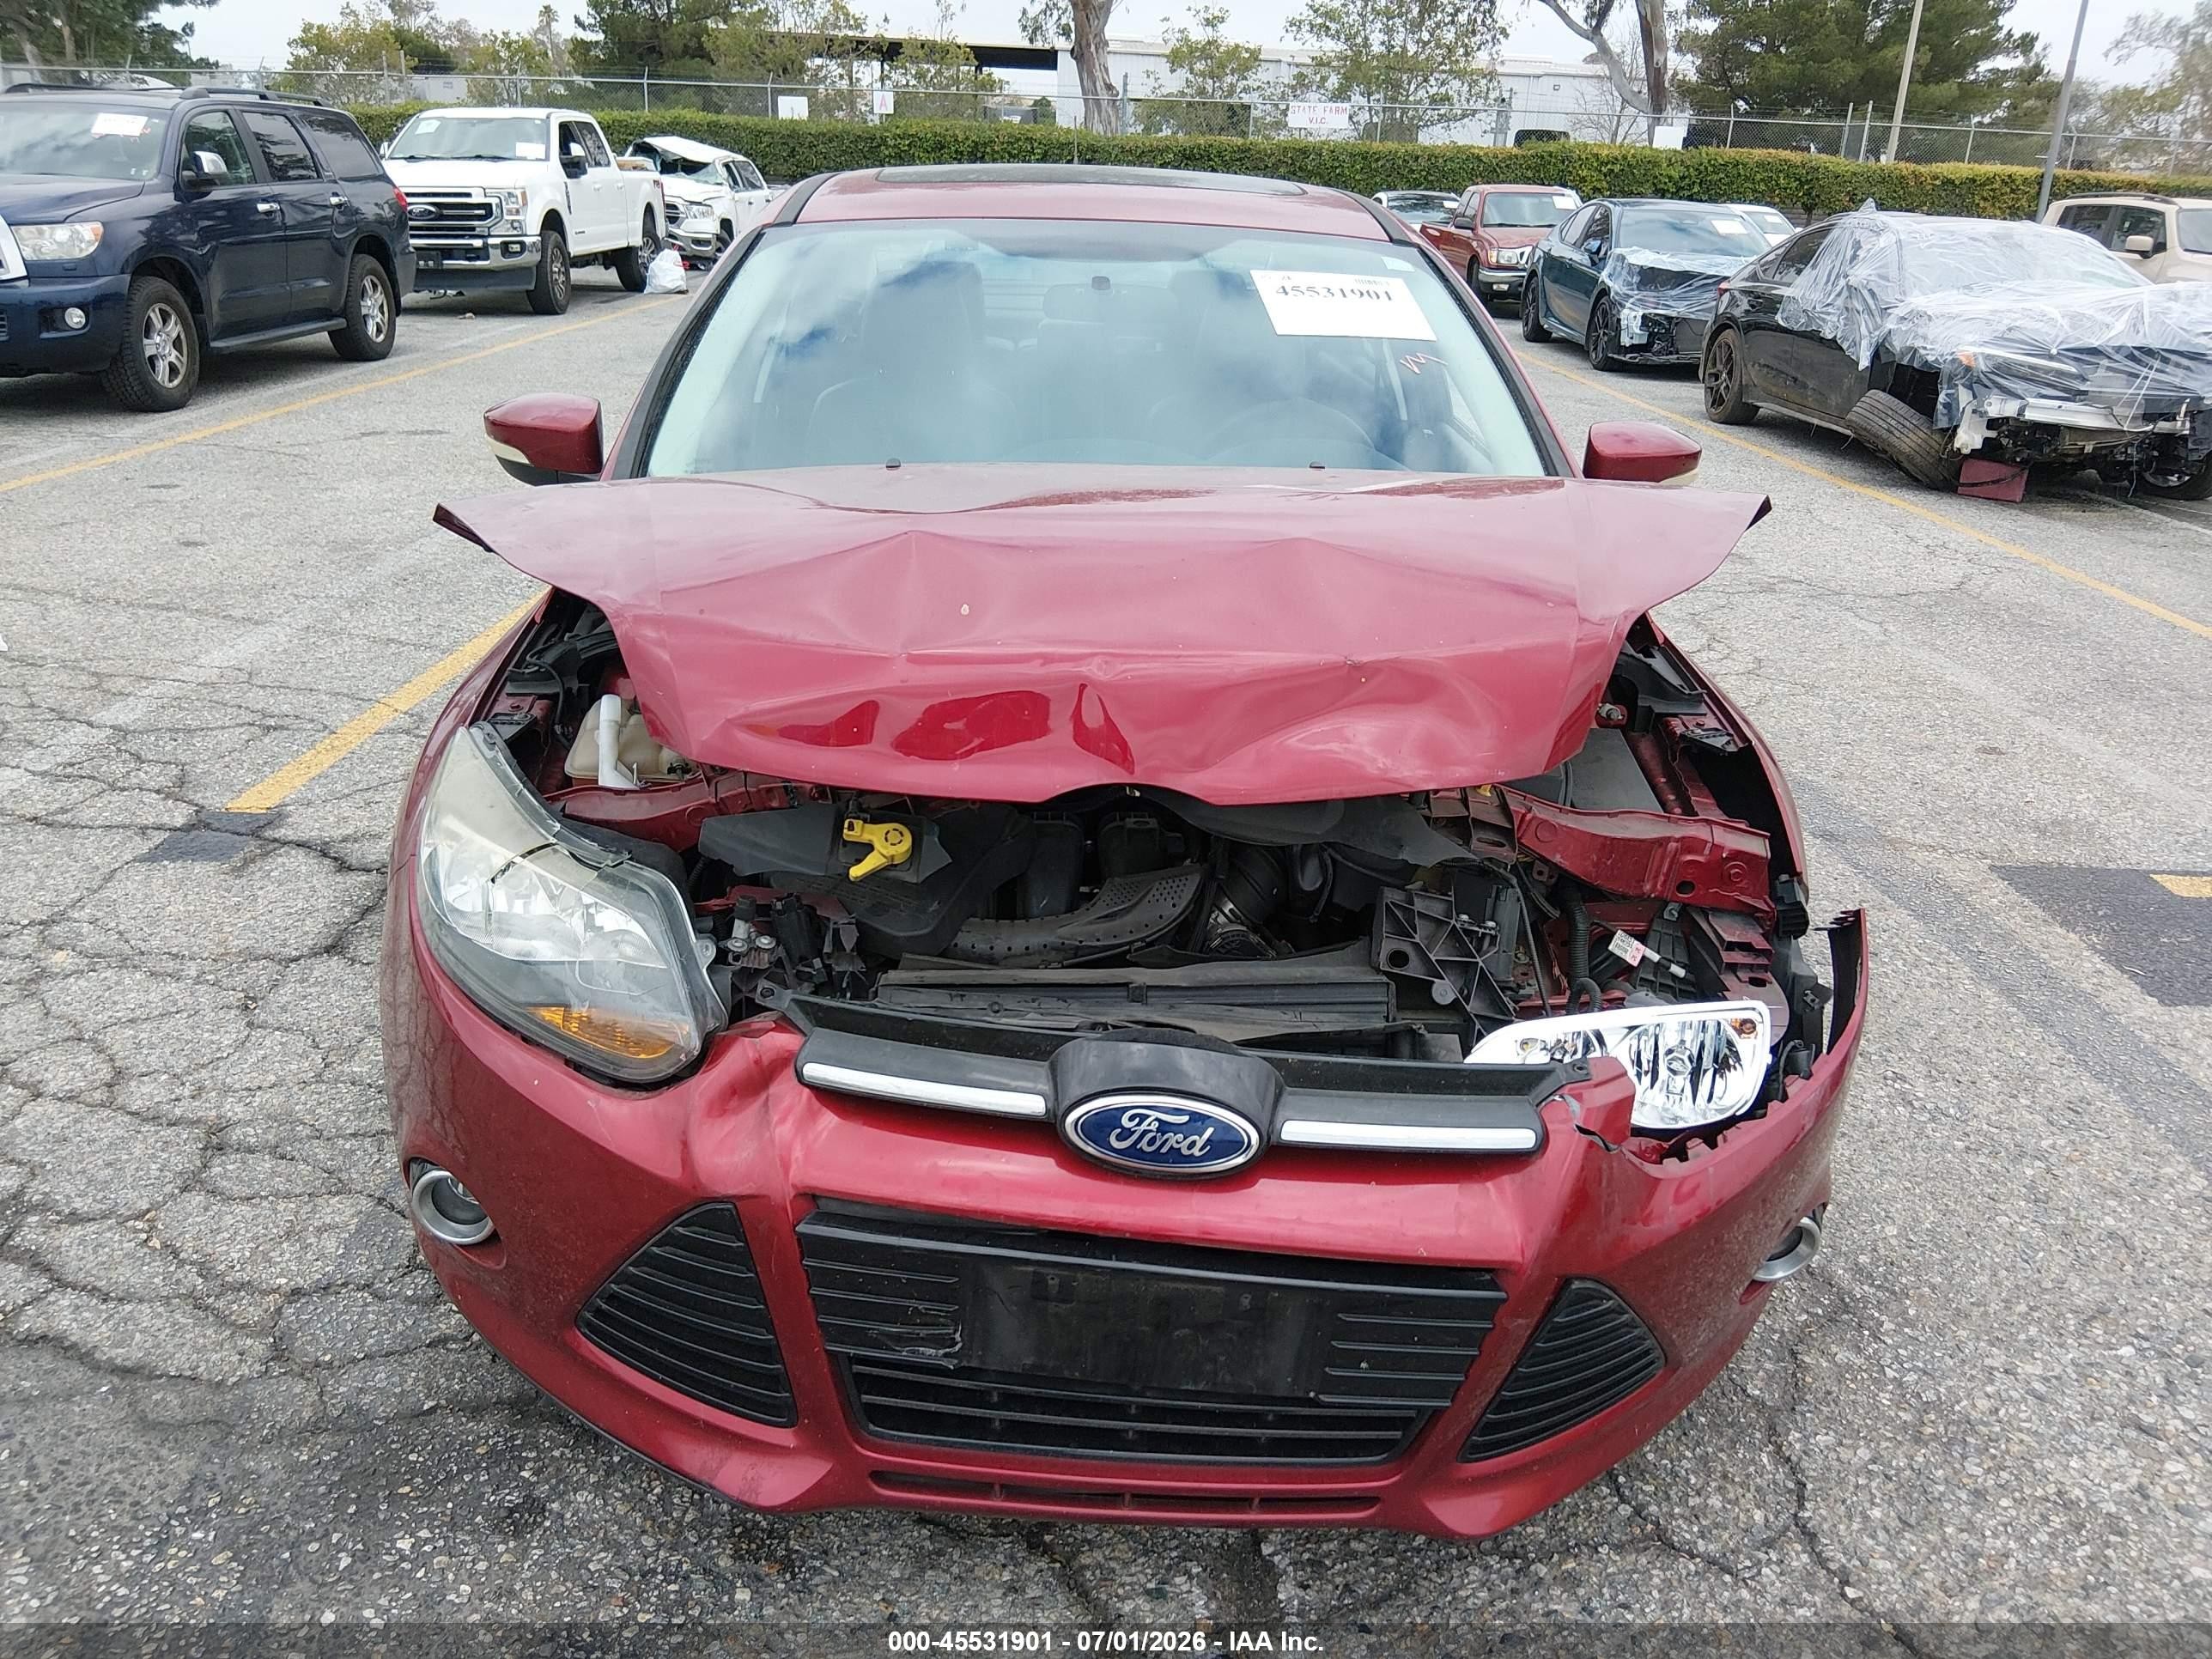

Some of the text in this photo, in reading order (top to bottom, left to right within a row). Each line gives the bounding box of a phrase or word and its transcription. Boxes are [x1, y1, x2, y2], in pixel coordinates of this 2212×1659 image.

[878, 93, 888, 111] A
[1291, 105, 1348, 116] STATE FARM
[1275, 284, 1394, 302] 45531901
[1109, 1108, 1215, 1158] Ford
